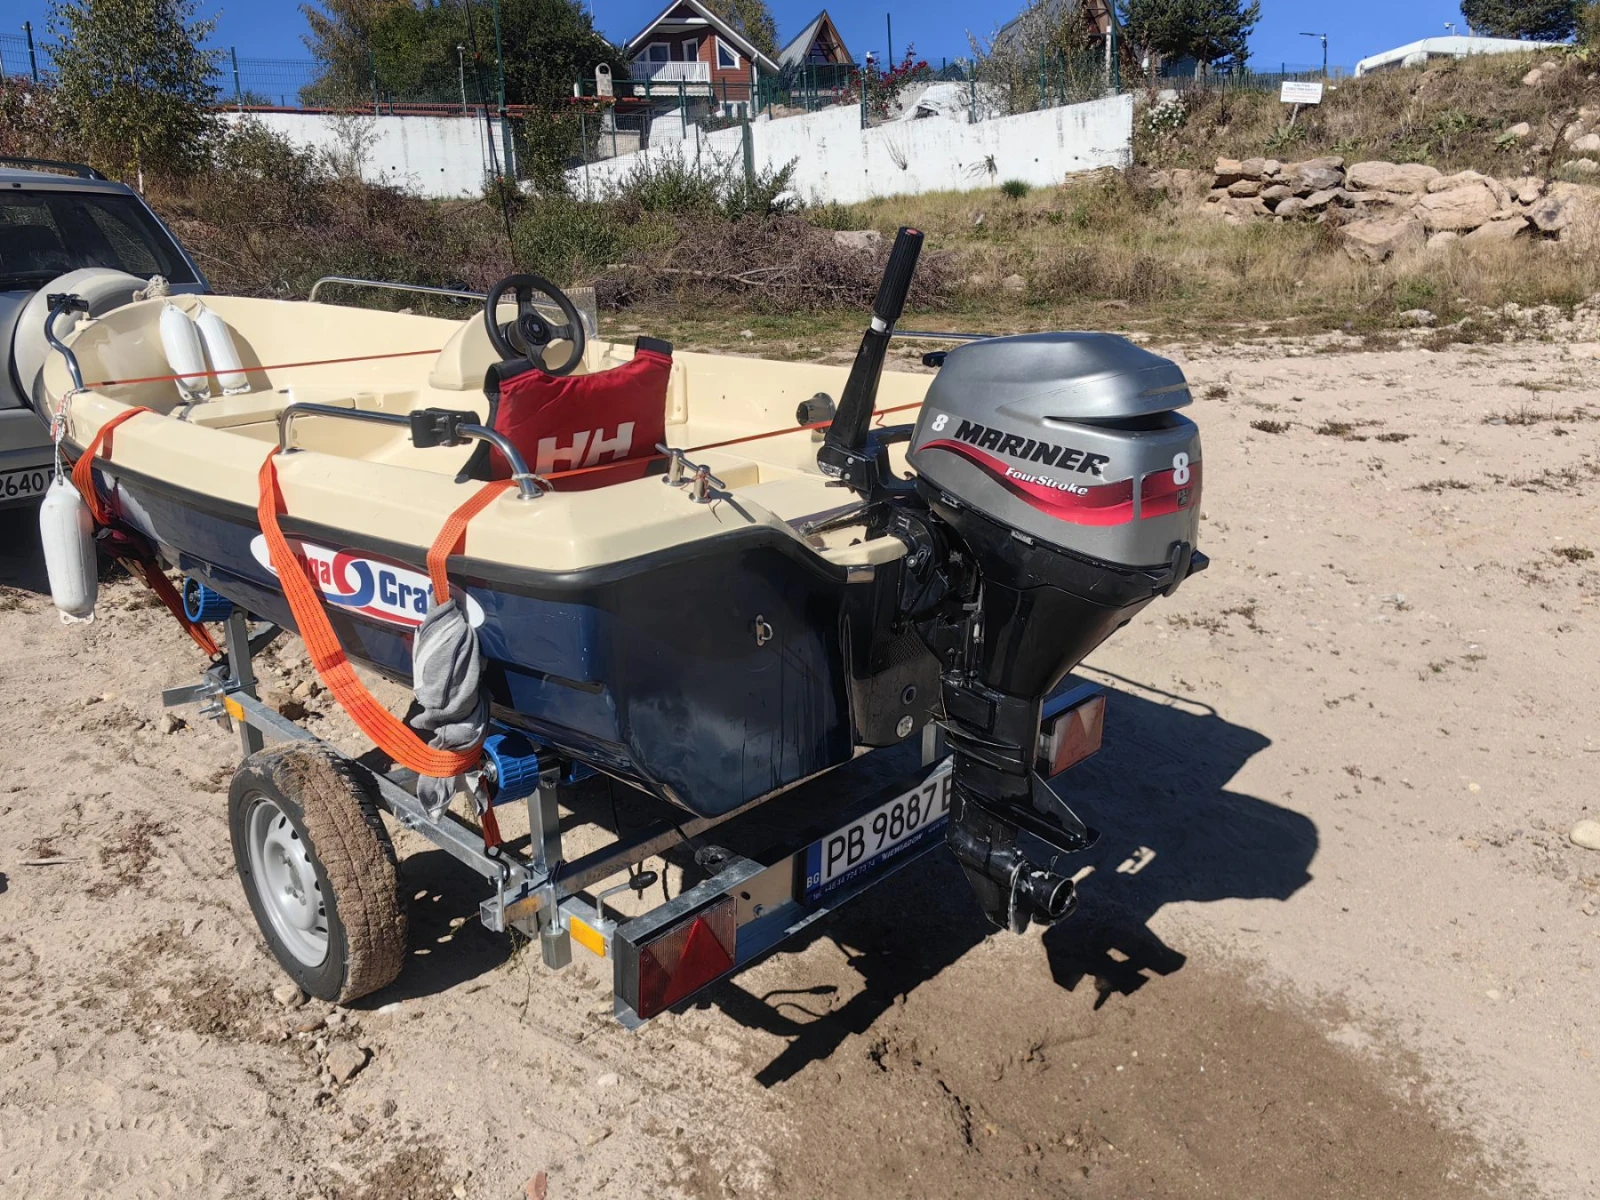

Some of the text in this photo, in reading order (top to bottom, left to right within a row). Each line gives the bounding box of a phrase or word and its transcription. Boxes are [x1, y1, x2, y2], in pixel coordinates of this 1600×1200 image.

[931, 414, 948, 432] 8
[535, 421, 636, 475] HH
[954, 419, 1110, 477] MARINER
[1005, 466, 1089, 496] FourStroke
[1172, 452, 1190, 485] 8
[379, 570, 433, 615] Cra
[827, 825, 865, 878] PB
[872, 782, 937, 850] 9887
[806, 872, 820, 889] BG
